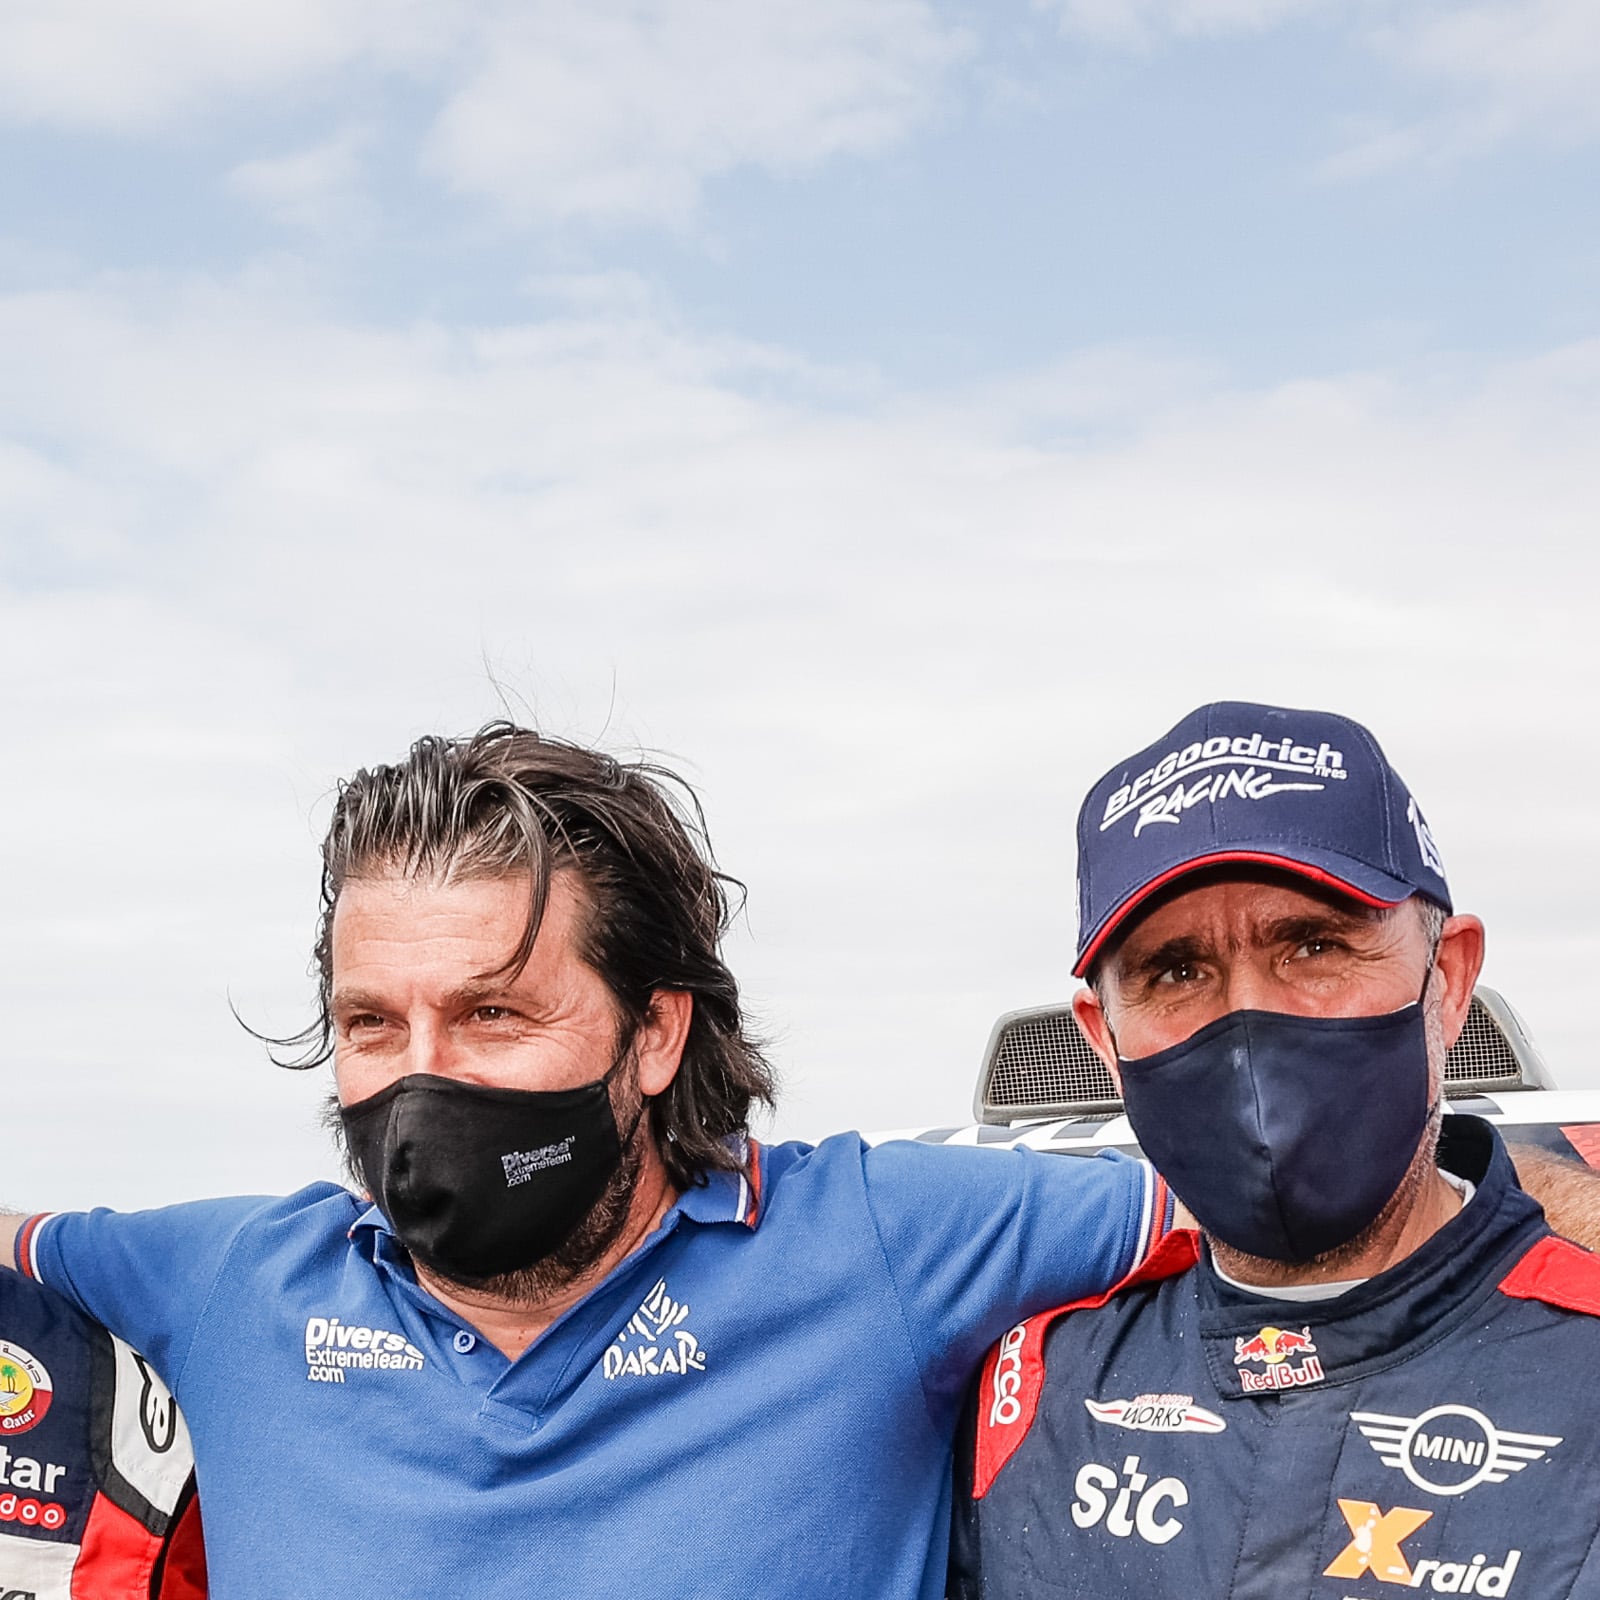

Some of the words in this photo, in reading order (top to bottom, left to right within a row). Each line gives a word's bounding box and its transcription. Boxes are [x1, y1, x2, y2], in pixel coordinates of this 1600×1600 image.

[1105, 733, 1344, 821] BFGoodrich
[1134, 767, 1325, 837] RACING
[305, 1345, 423, 1371] ExtremeTeam
[604, 1331, 705, 1380] DAKAR
[307, 1366, 345, 1383] .com
[1238, 1364, 1277, 1392] Red
[1277, 1356, 1325, 1389] Bull
[1121, 1406, 1187, 1427] WORKS
[1413, 1432, 1484, 1467] MINI
[1071, 1455, 1189, 1544] stc
